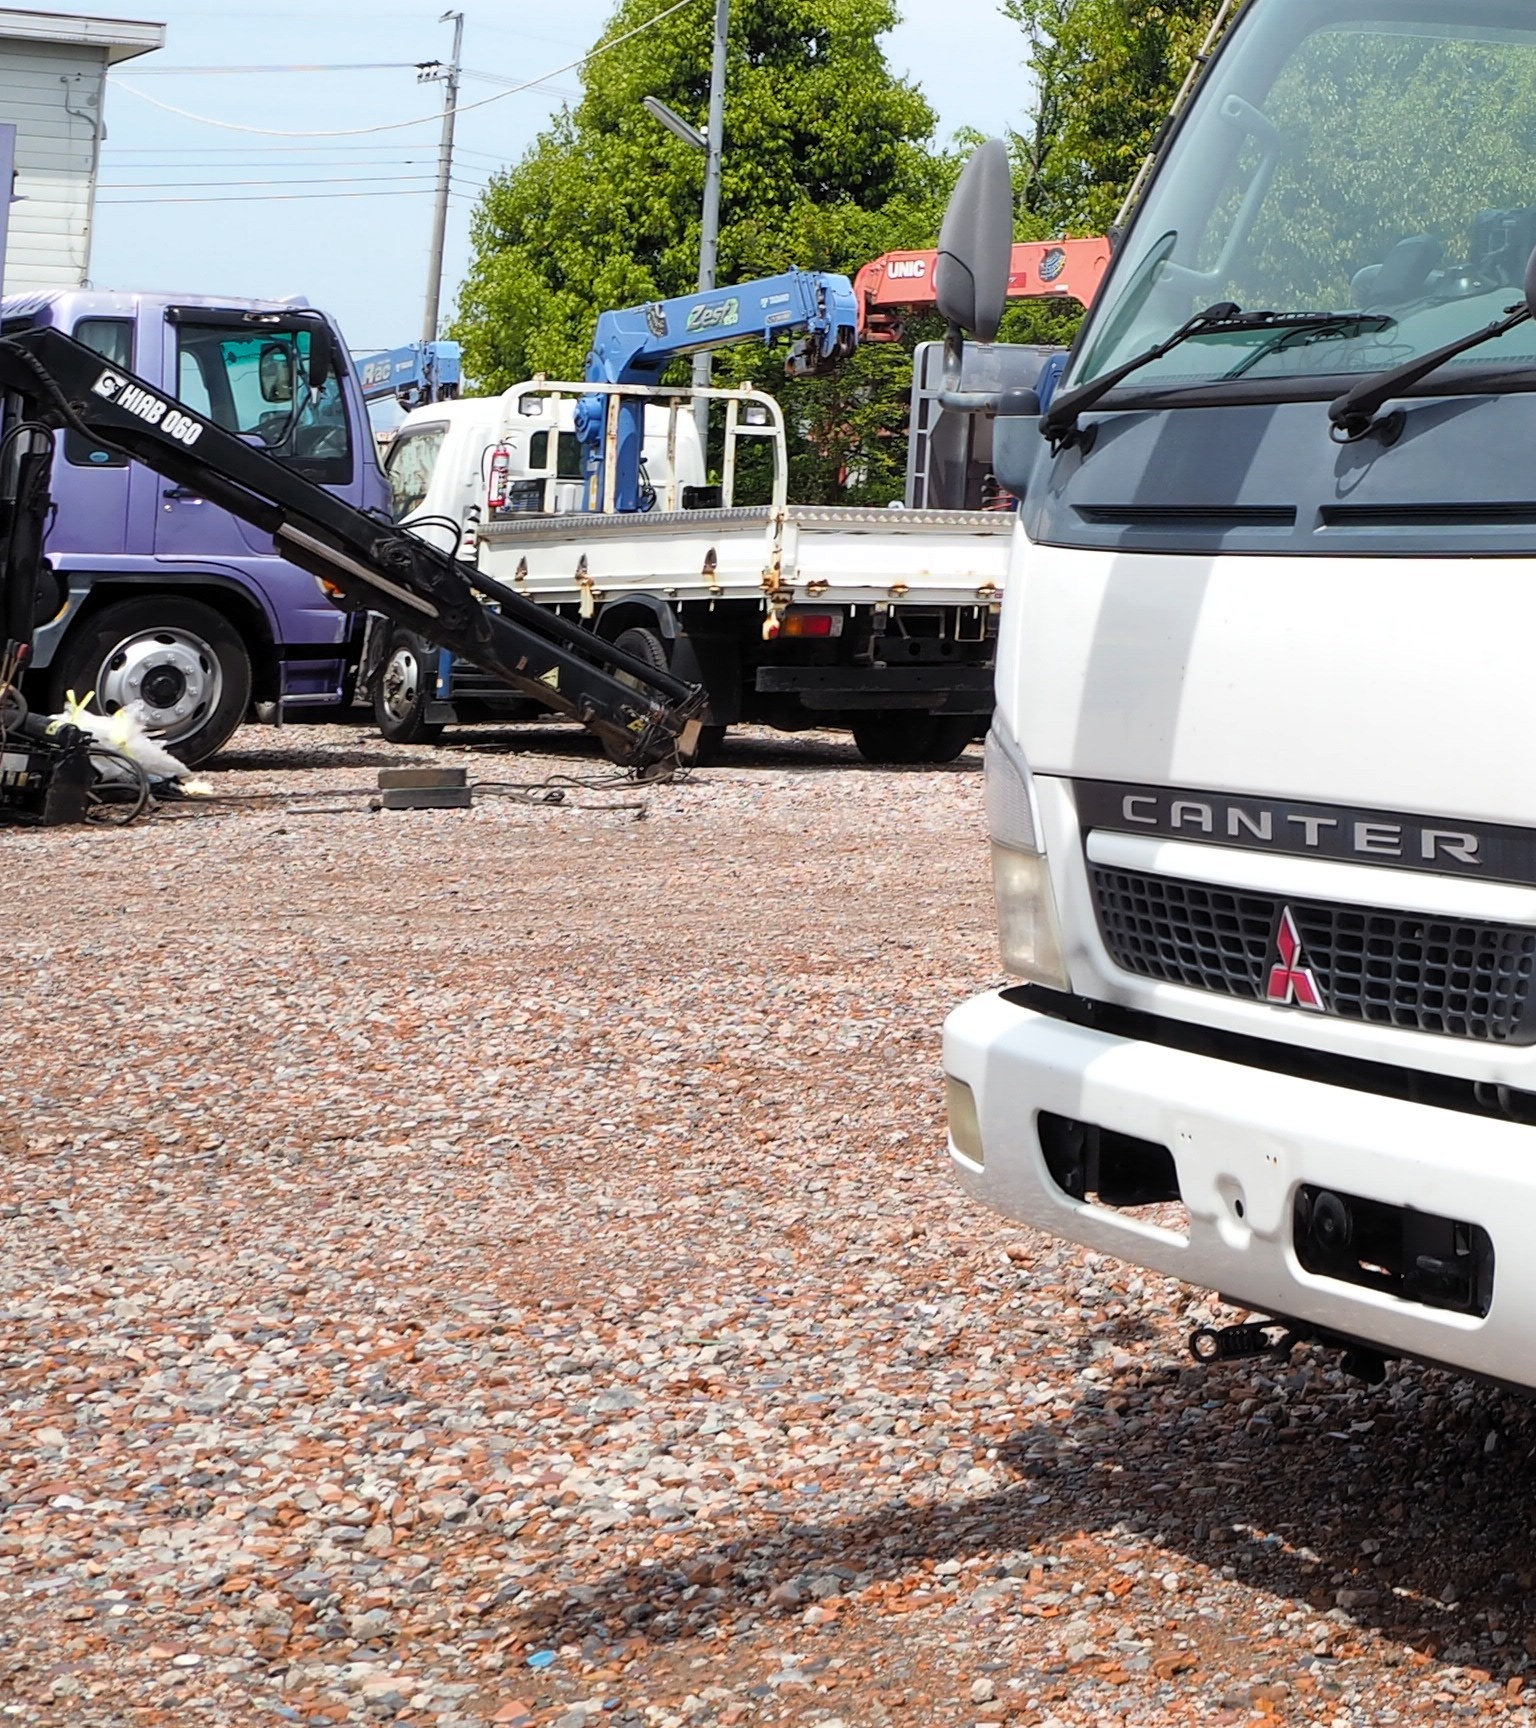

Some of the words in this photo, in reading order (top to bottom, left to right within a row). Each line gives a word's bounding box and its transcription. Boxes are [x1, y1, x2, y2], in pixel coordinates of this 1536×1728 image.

[888, 260, 926, 278] UNIC
[117, 383, 168, 425] HIAB
[160, 410, 204, 445] 060
[1122, 794, 1481, 865] CANTER
